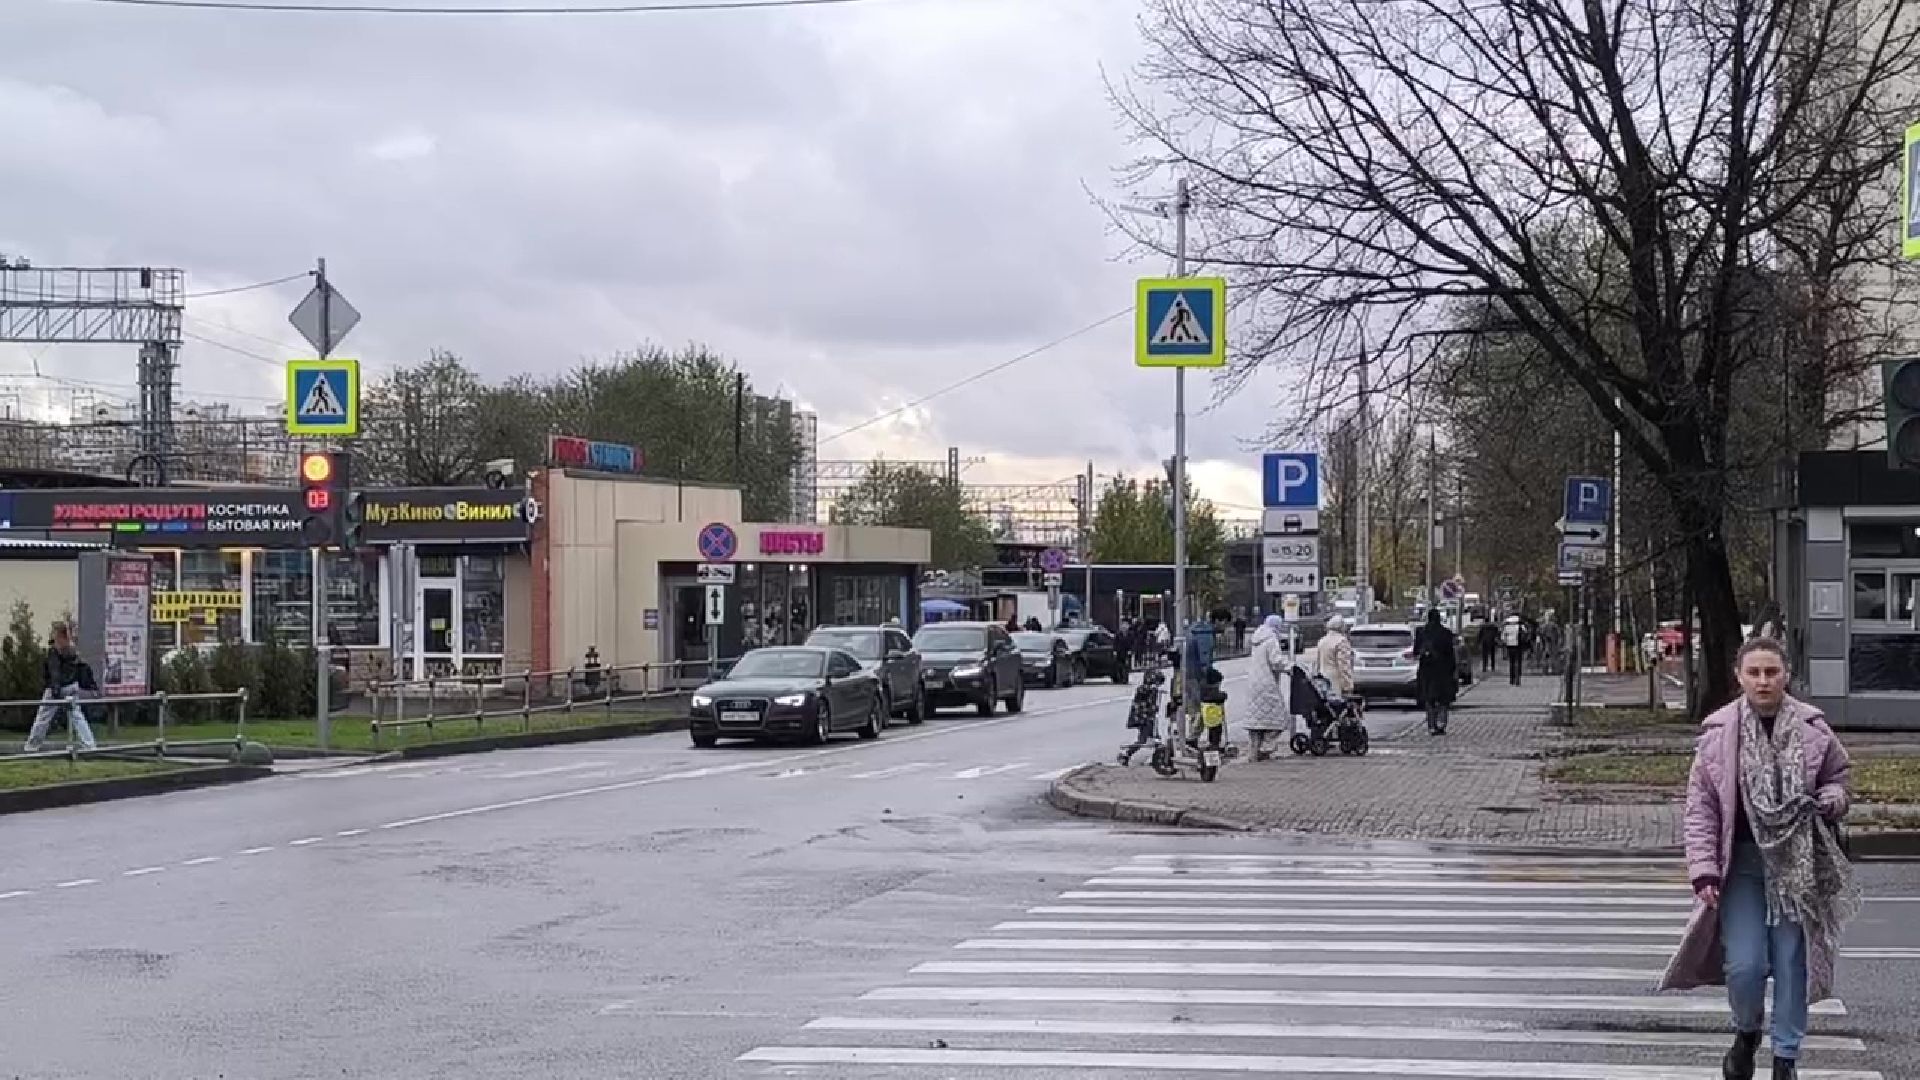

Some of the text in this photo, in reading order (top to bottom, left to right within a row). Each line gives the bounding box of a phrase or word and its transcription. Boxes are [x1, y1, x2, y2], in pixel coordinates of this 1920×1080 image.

[1278, 459, 1309, 502] P
[308, 490, 328, 508] 03
[1579, 483, 1599, 511] P
[207, 504, 289, 516] КОСМЕТИКА
[456, 501, 512, 520] Винил
[207, 520, 269, 532] БЫТОВАЯ
